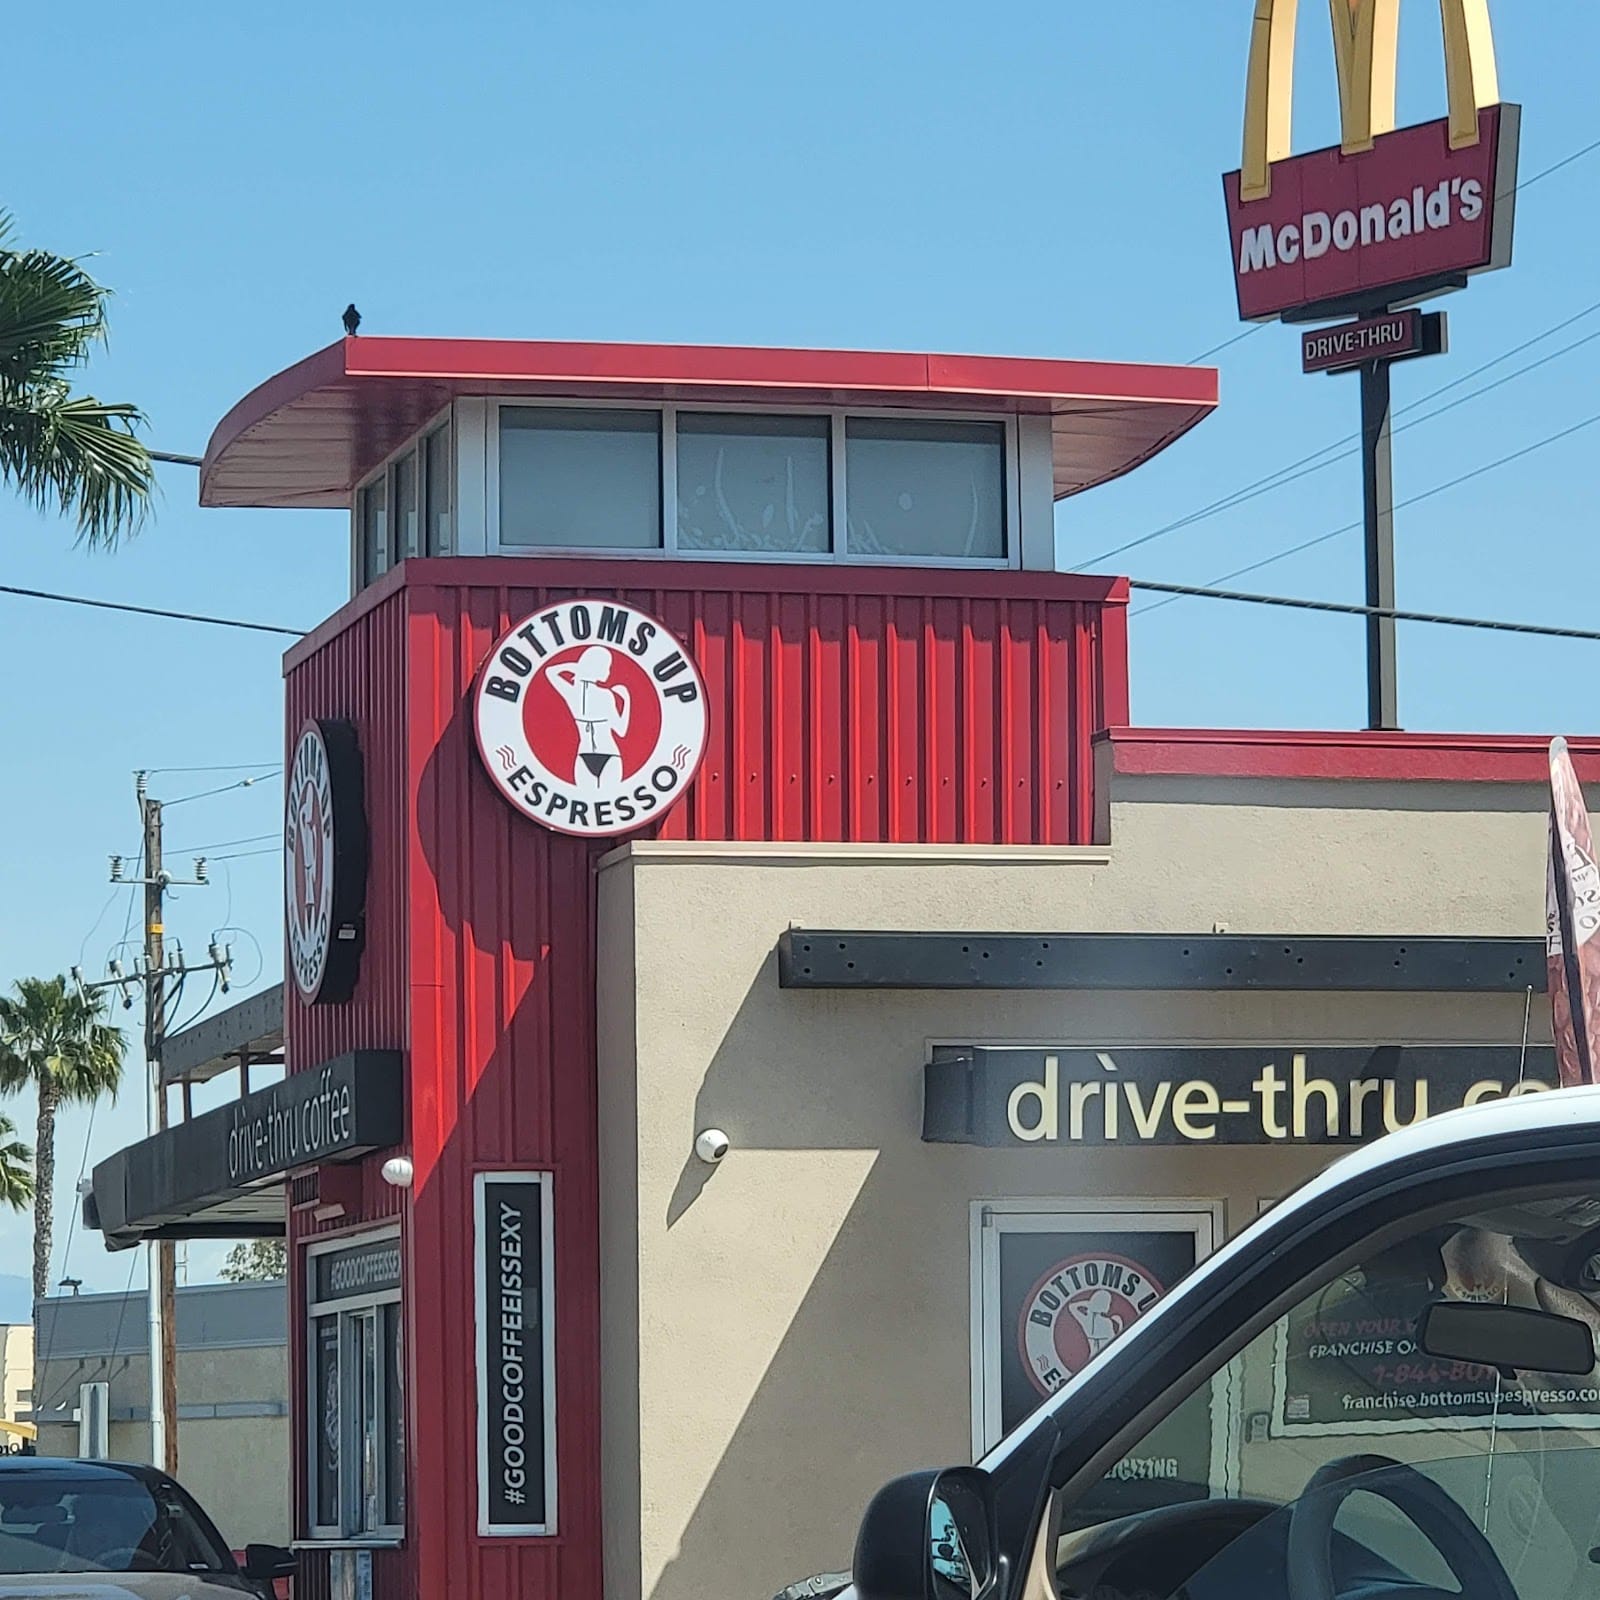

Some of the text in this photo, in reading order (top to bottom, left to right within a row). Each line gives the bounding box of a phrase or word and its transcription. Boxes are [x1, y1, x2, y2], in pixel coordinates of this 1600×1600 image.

[1239, 177, 1483, 274] McDonald's
[1305, 321, 1403, 360] DRIVE-THRU
[485, 605, 698, 703] BOTTOMS UP
[506, 765, 678, 827] ESPRESSO
[228, 1067, 351, 1180] drive-thru coffee
[1030, 1262, 1141, 1328] BOTTOMS
[500, 1202, 526, 1505] #GOODCOFFEEISSEXY
[1309, 1339, 1394, 1359] FRANCHISE
[1342, 1388, 1600, 1410] franchise.bottomsupespresso.co
